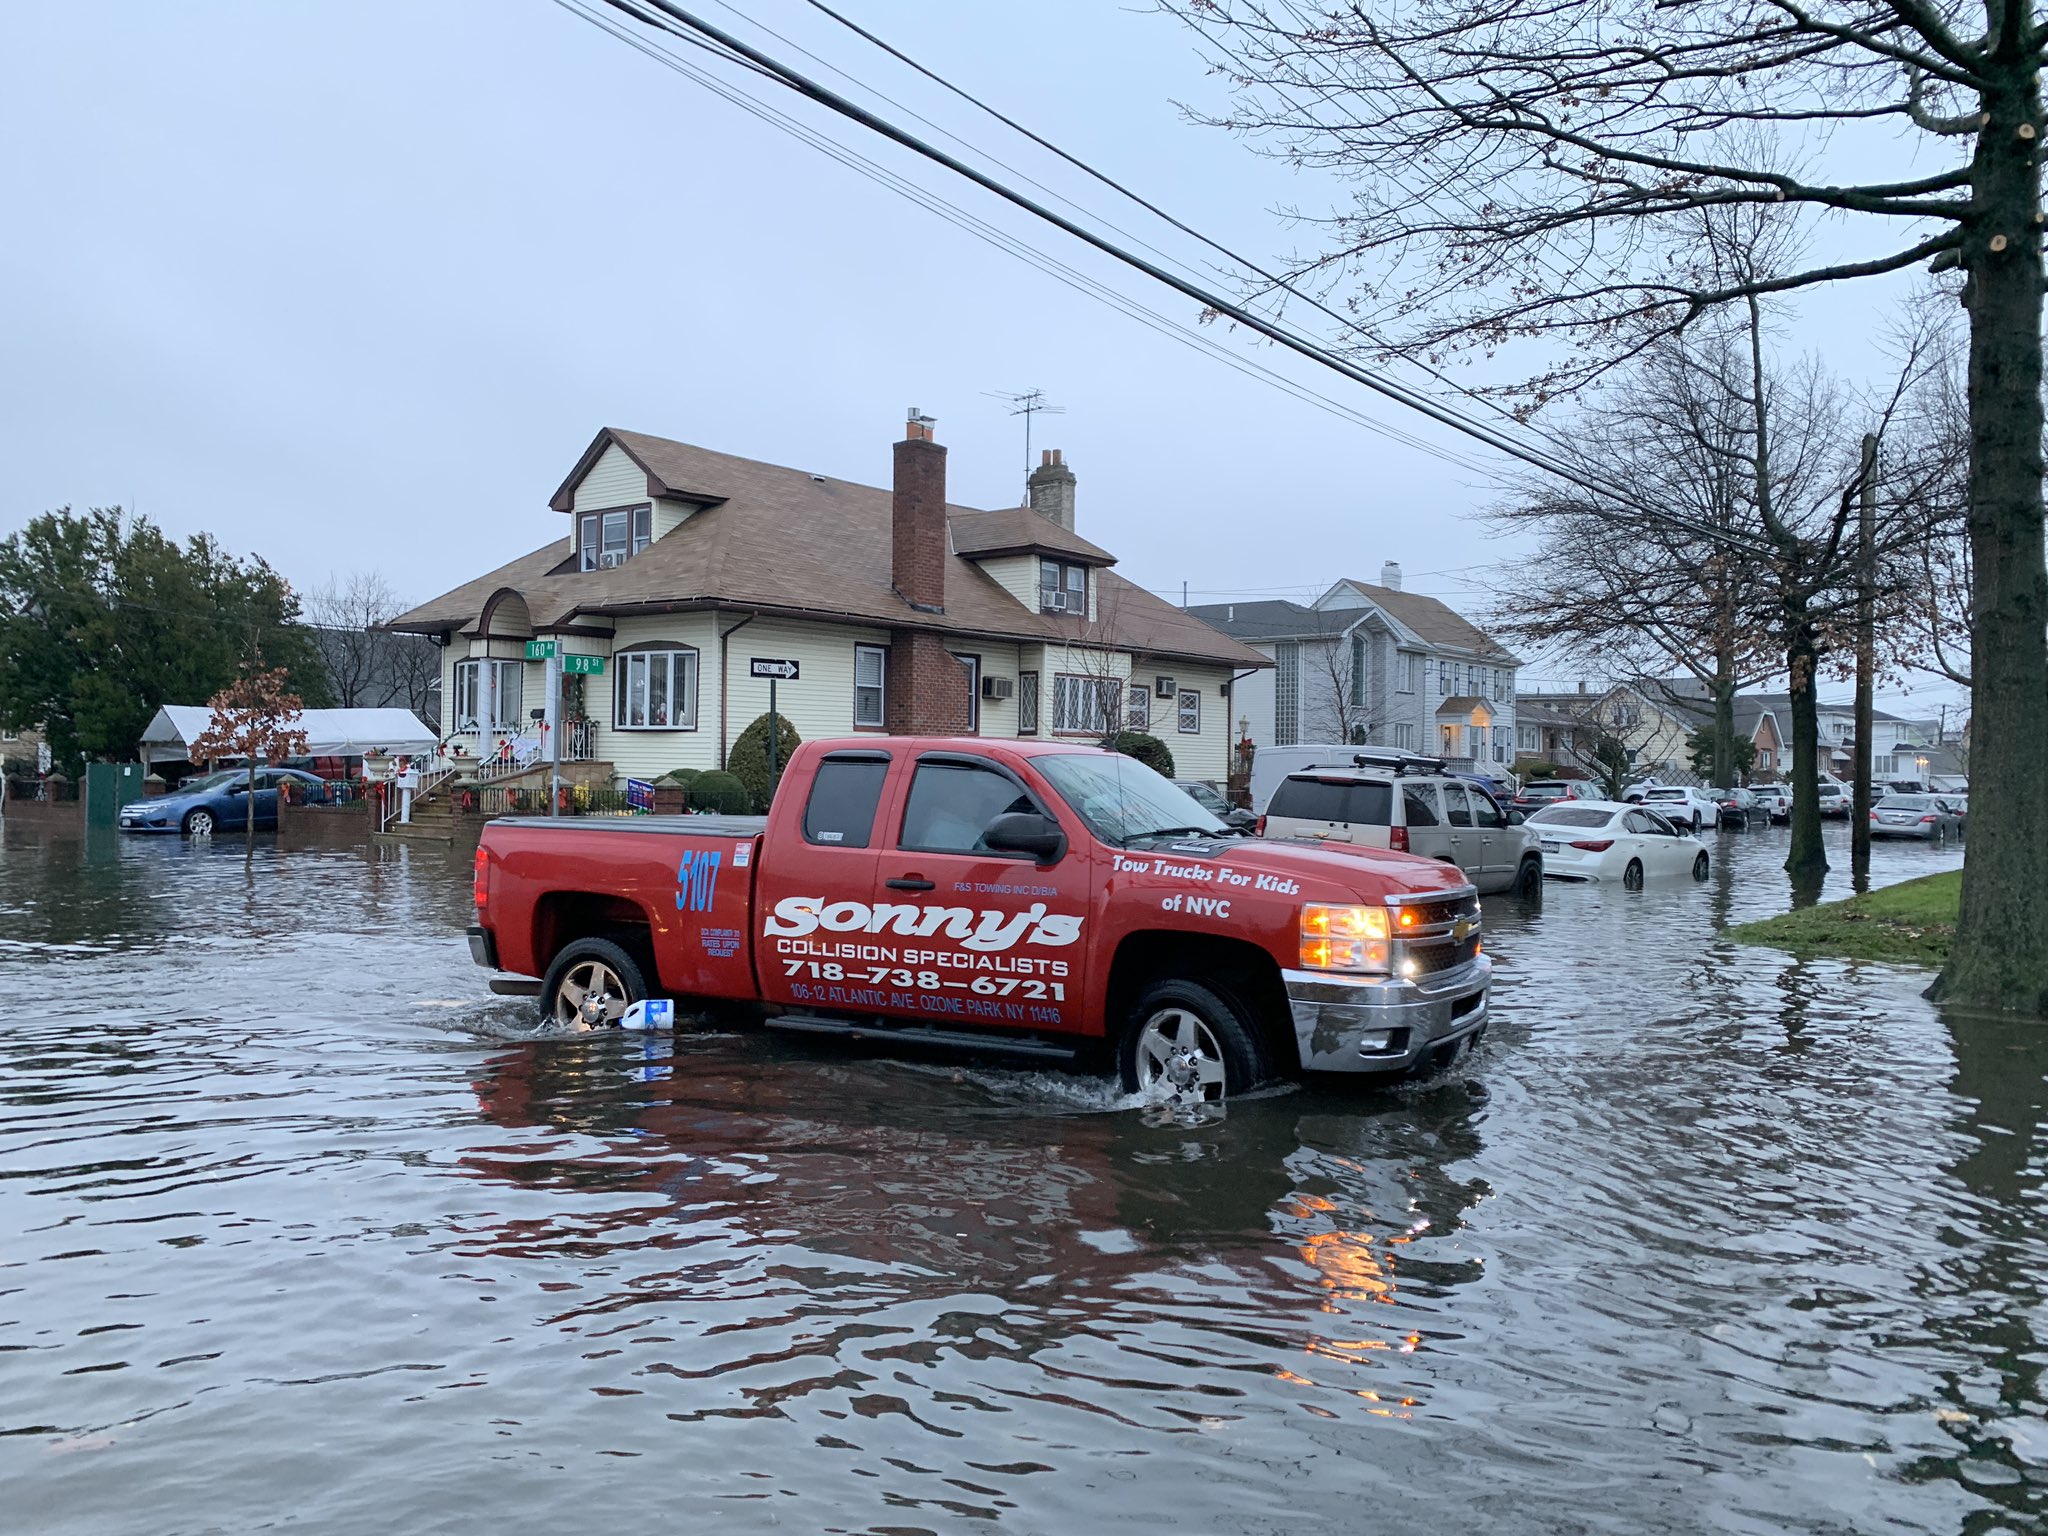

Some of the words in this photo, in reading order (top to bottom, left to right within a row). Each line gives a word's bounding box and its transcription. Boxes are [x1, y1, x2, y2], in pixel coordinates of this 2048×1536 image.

[531, 643, 545, 656] 160
[576, 658, 589, 671] 98
[592, 658, 599, 667] St
[757, 664, 772, 672] ONE
[777, 665, 793, 674] WAY
[675, 850, 721, 912] 5107
[954, 881, 971, 892] F&S
[974, 883, 1011, 895] TOWING
[1013, 886, 1029, 895] INC
[1113, 855, 1149, 873] Tow
[1154, 859, 1214, 881] Trucks
[1217, 868, 1252, 886] For
[1255, 873, 1300, 895] Kids
[1161, 894, 1182, 912] of
[1186, 896, 1231, 918] NYC
[763, 896, 1085, 952] Sonny's
[777, 939, 897, 962] COLLISION
[903, 949, 1069, 976] SPECIALISTS
[790, 983, 826, 1001] 106-12
[829, 986, 886, 1005] ATLANTIC
[920, 994, 964, 1014] OZONE
[966, 999, 1003, 1018] PARK
[1005, 1003, 1024, 1020] NY
[1029, 1006, 1061, 1024] 11416
